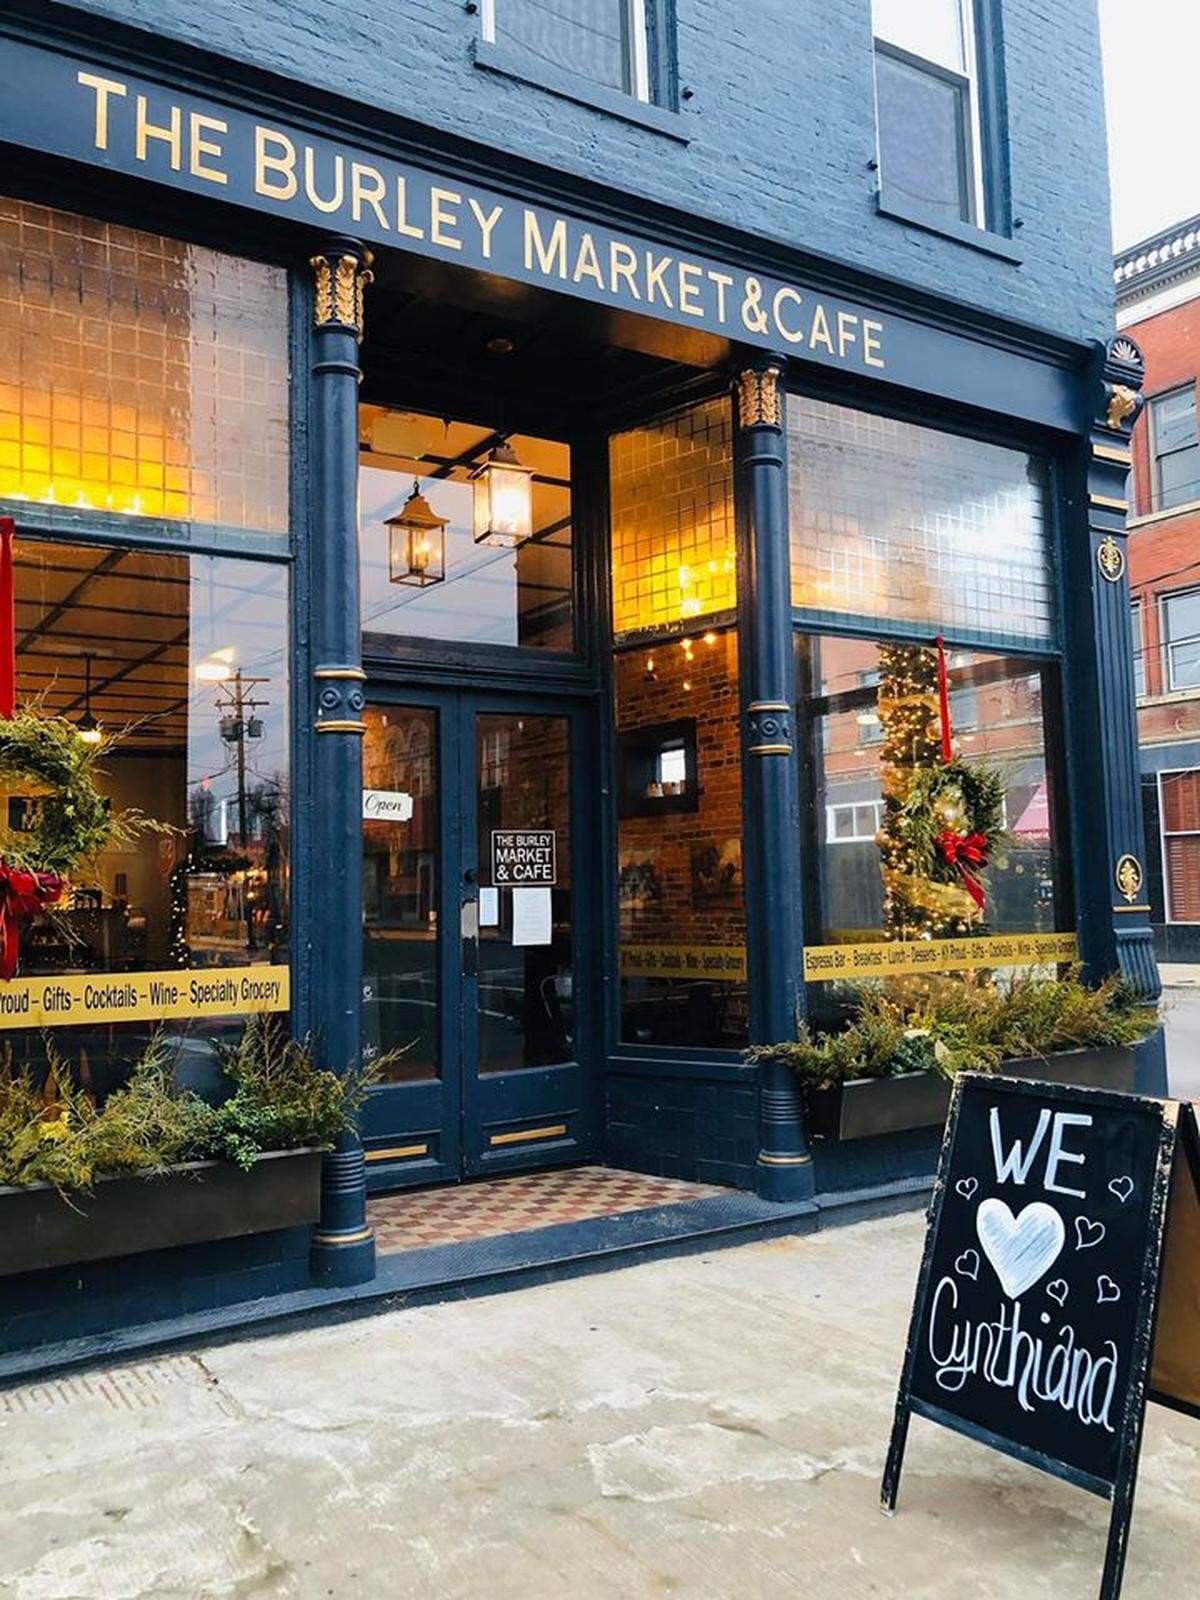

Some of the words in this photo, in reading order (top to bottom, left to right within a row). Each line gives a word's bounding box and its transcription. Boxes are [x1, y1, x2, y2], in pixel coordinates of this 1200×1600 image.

[77, 70, 228, 185] THE
[254, 124, 504, 259] BURLEY
[364, 792, 402, 816] Open
[495, 834, 514, 847] THE
[516, 834, 551, 847] BURLEY
[496, 847, 552, 863] MARKET
[496, 864, 510, 881] &
[512, 864, 553, 880] CAFE
[0, 987, 29, 1014] roud
[43, 985, 72, 1012] Gifts
[84, 983, 138, 1010] Cocktails
[149, 980, 179, 1006] Wine
[189, 978, 239, 1010] Specialty
[240, 976, 281, 1004] Grocery
[989, 1105, 1094, 1199] WE
[928, 1276, 1118, 1433] Cynthiana
